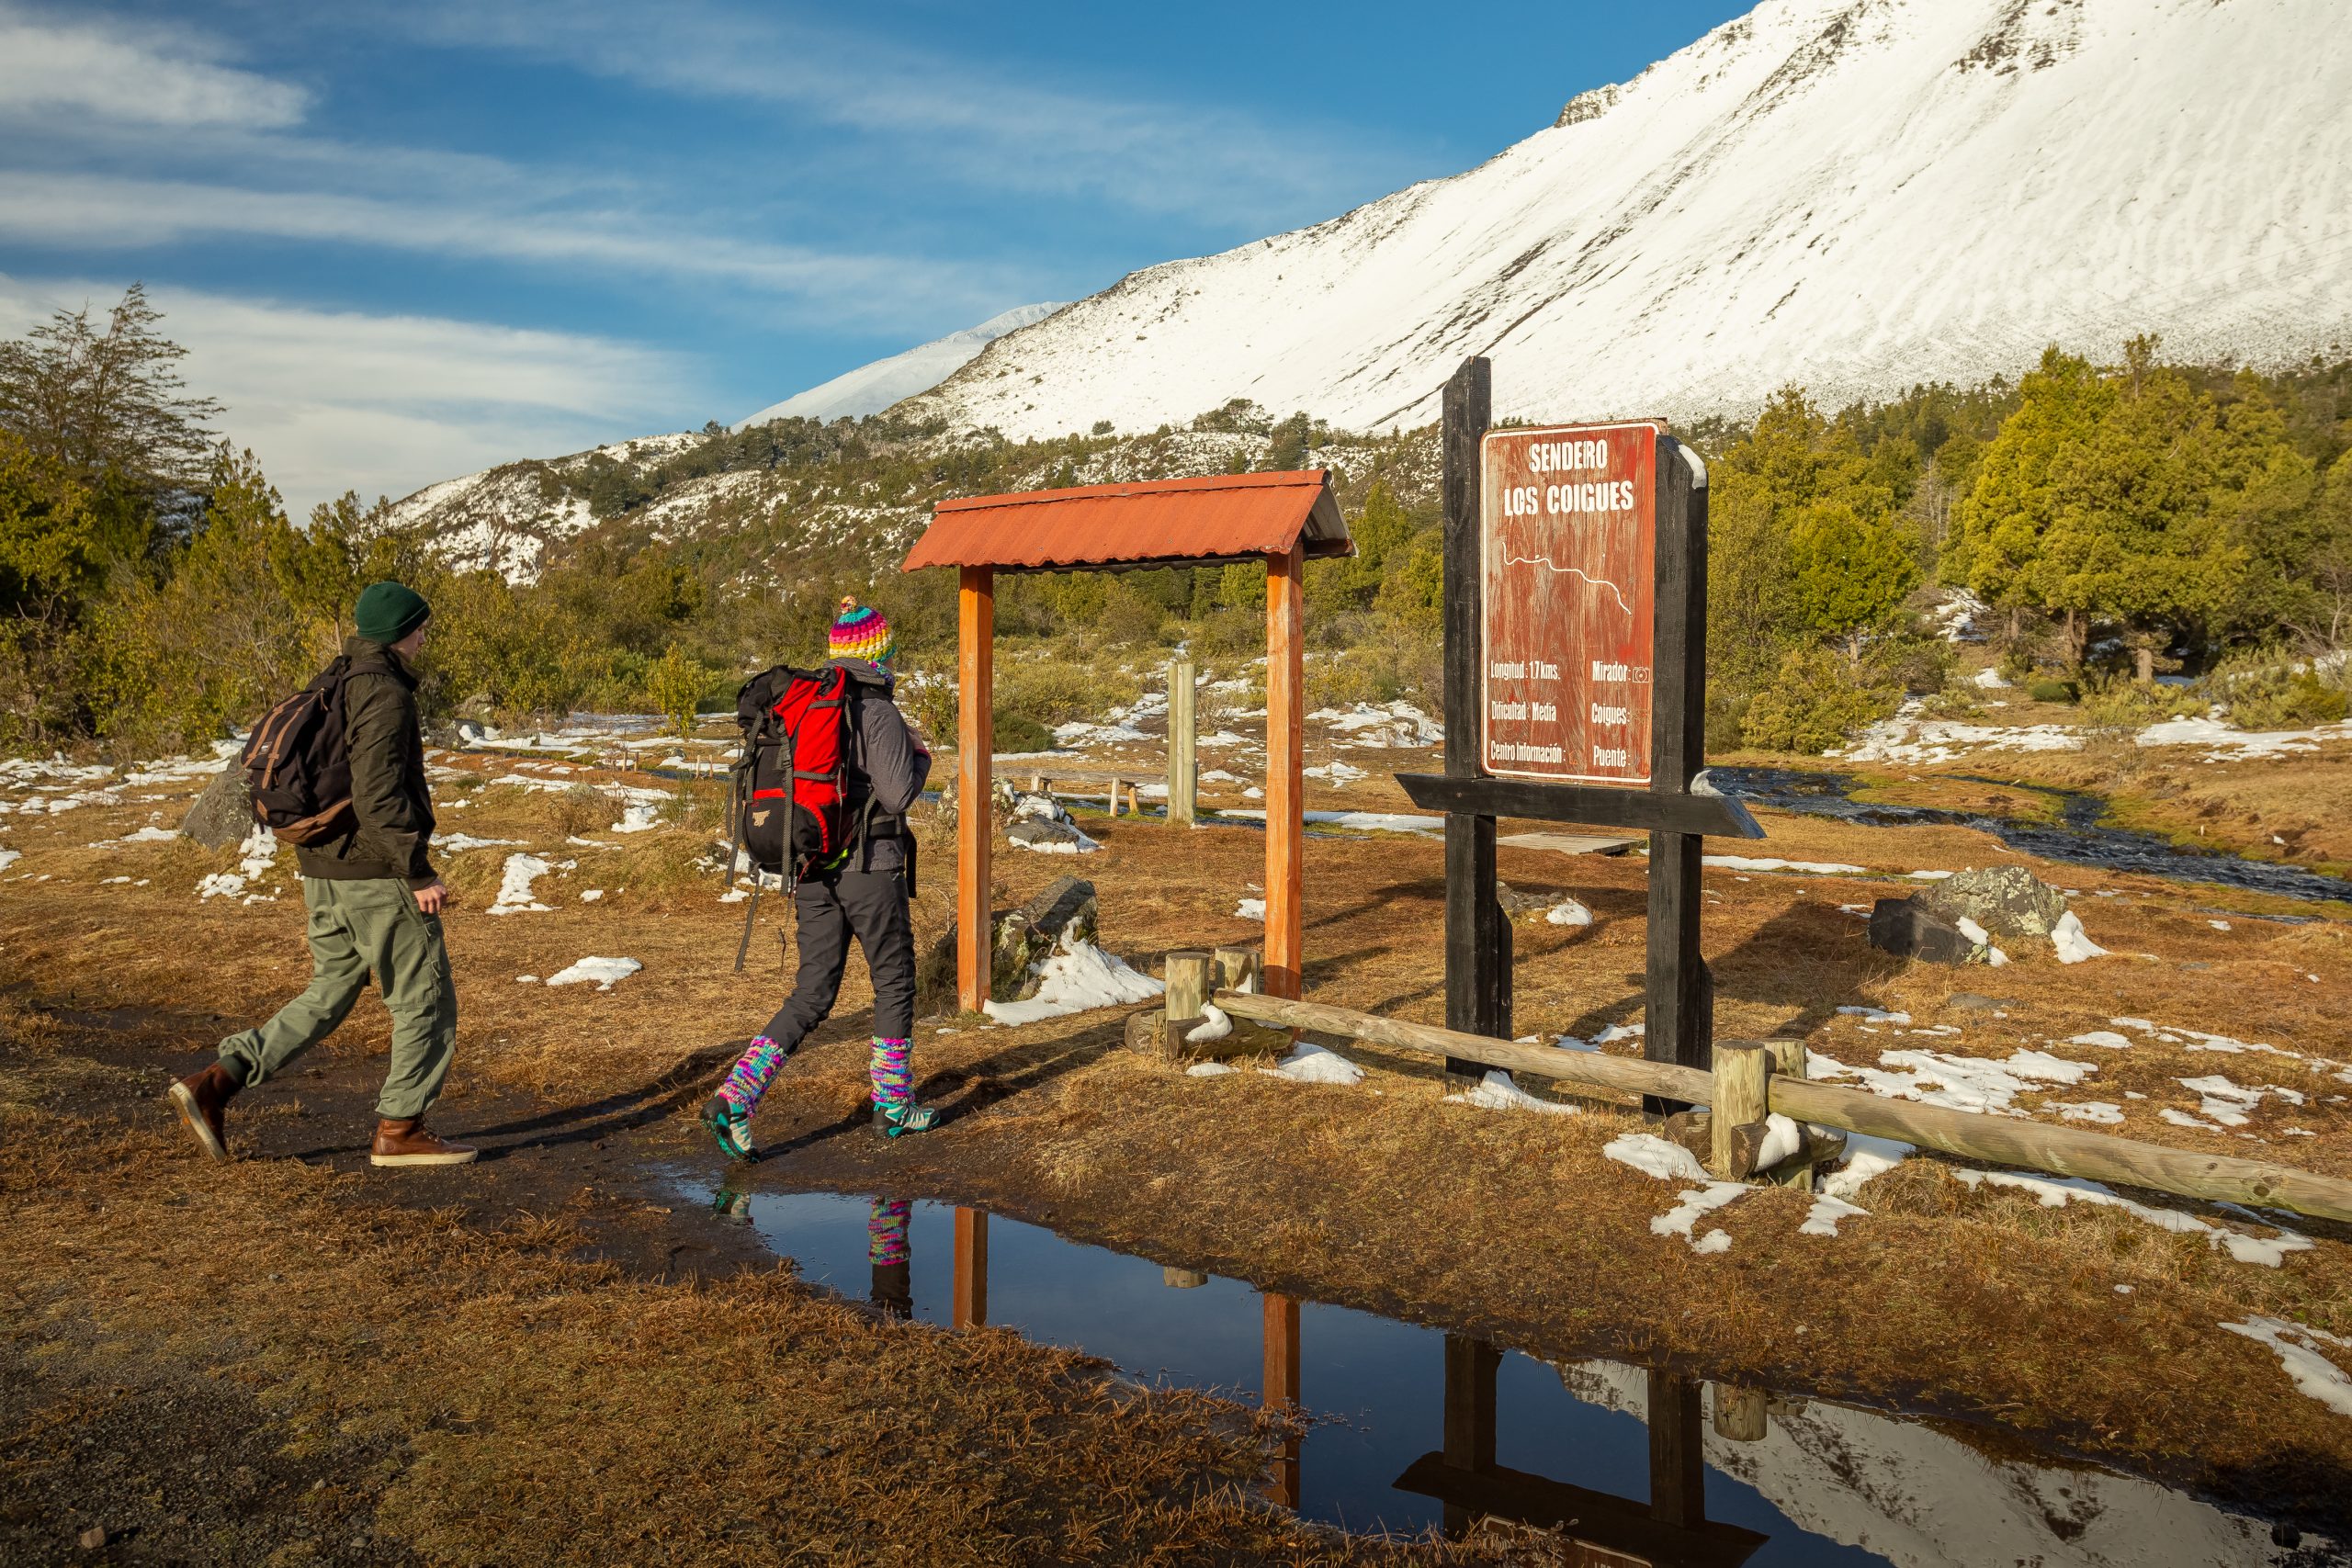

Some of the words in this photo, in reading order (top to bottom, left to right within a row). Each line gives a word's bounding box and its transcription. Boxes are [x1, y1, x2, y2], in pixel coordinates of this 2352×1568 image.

[1529, 439, 1608, 473] SENDERO
[1504, 486, 1539, 516] LOS
[1546, 480, 1634, 514] COIGUES
[1541, 660, 1561, 680] kms.
[1532, 701, 1556, 722] Media
[1490, 739, 1516, 761] Centro
